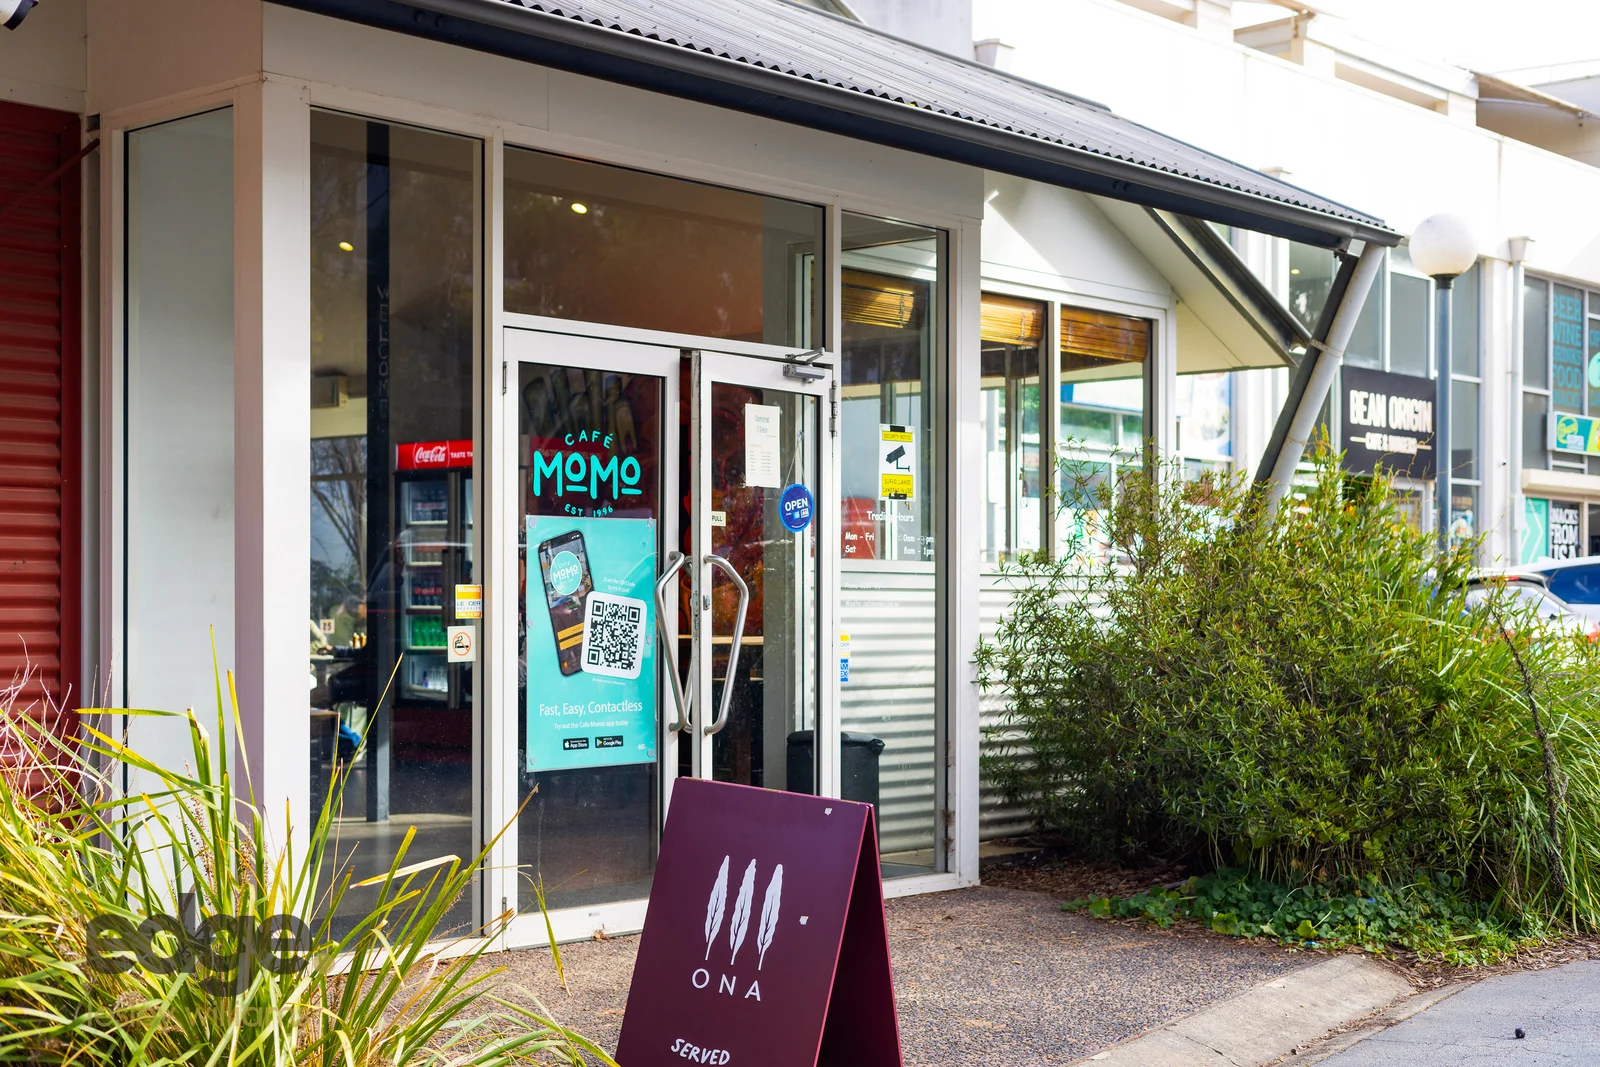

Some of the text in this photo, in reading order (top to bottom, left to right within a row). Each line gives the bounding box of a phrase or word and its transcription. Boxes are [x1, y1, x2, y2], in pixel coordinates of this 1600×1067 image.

[1350, 389, 1433, 433] BEAN ORIGIN
[564, 429, 615, 449] CAFÉ
[450, 451, 466, 459] TASTE
[533, 450, 643, 500] MOMO
[592, 505, 614, 518] 1996
[784, 497, 809, 512] OPEN
[844, 531, 858, 541] Mon
[865, 532, 875, 541] Fri
[844, 545, 857, 554] Sat
[903, 546, 916, 555] 8am
[552, 564, 579, 583] MOMO
[539, 699, 643, 717] Fast, Easy, Contactless
[589, 720, 606, 728] Momo
[615, 719, 629, 727] today
[691, 967, 761, 1002] ONA
[670, 1038, 731, 1066] SERVED
